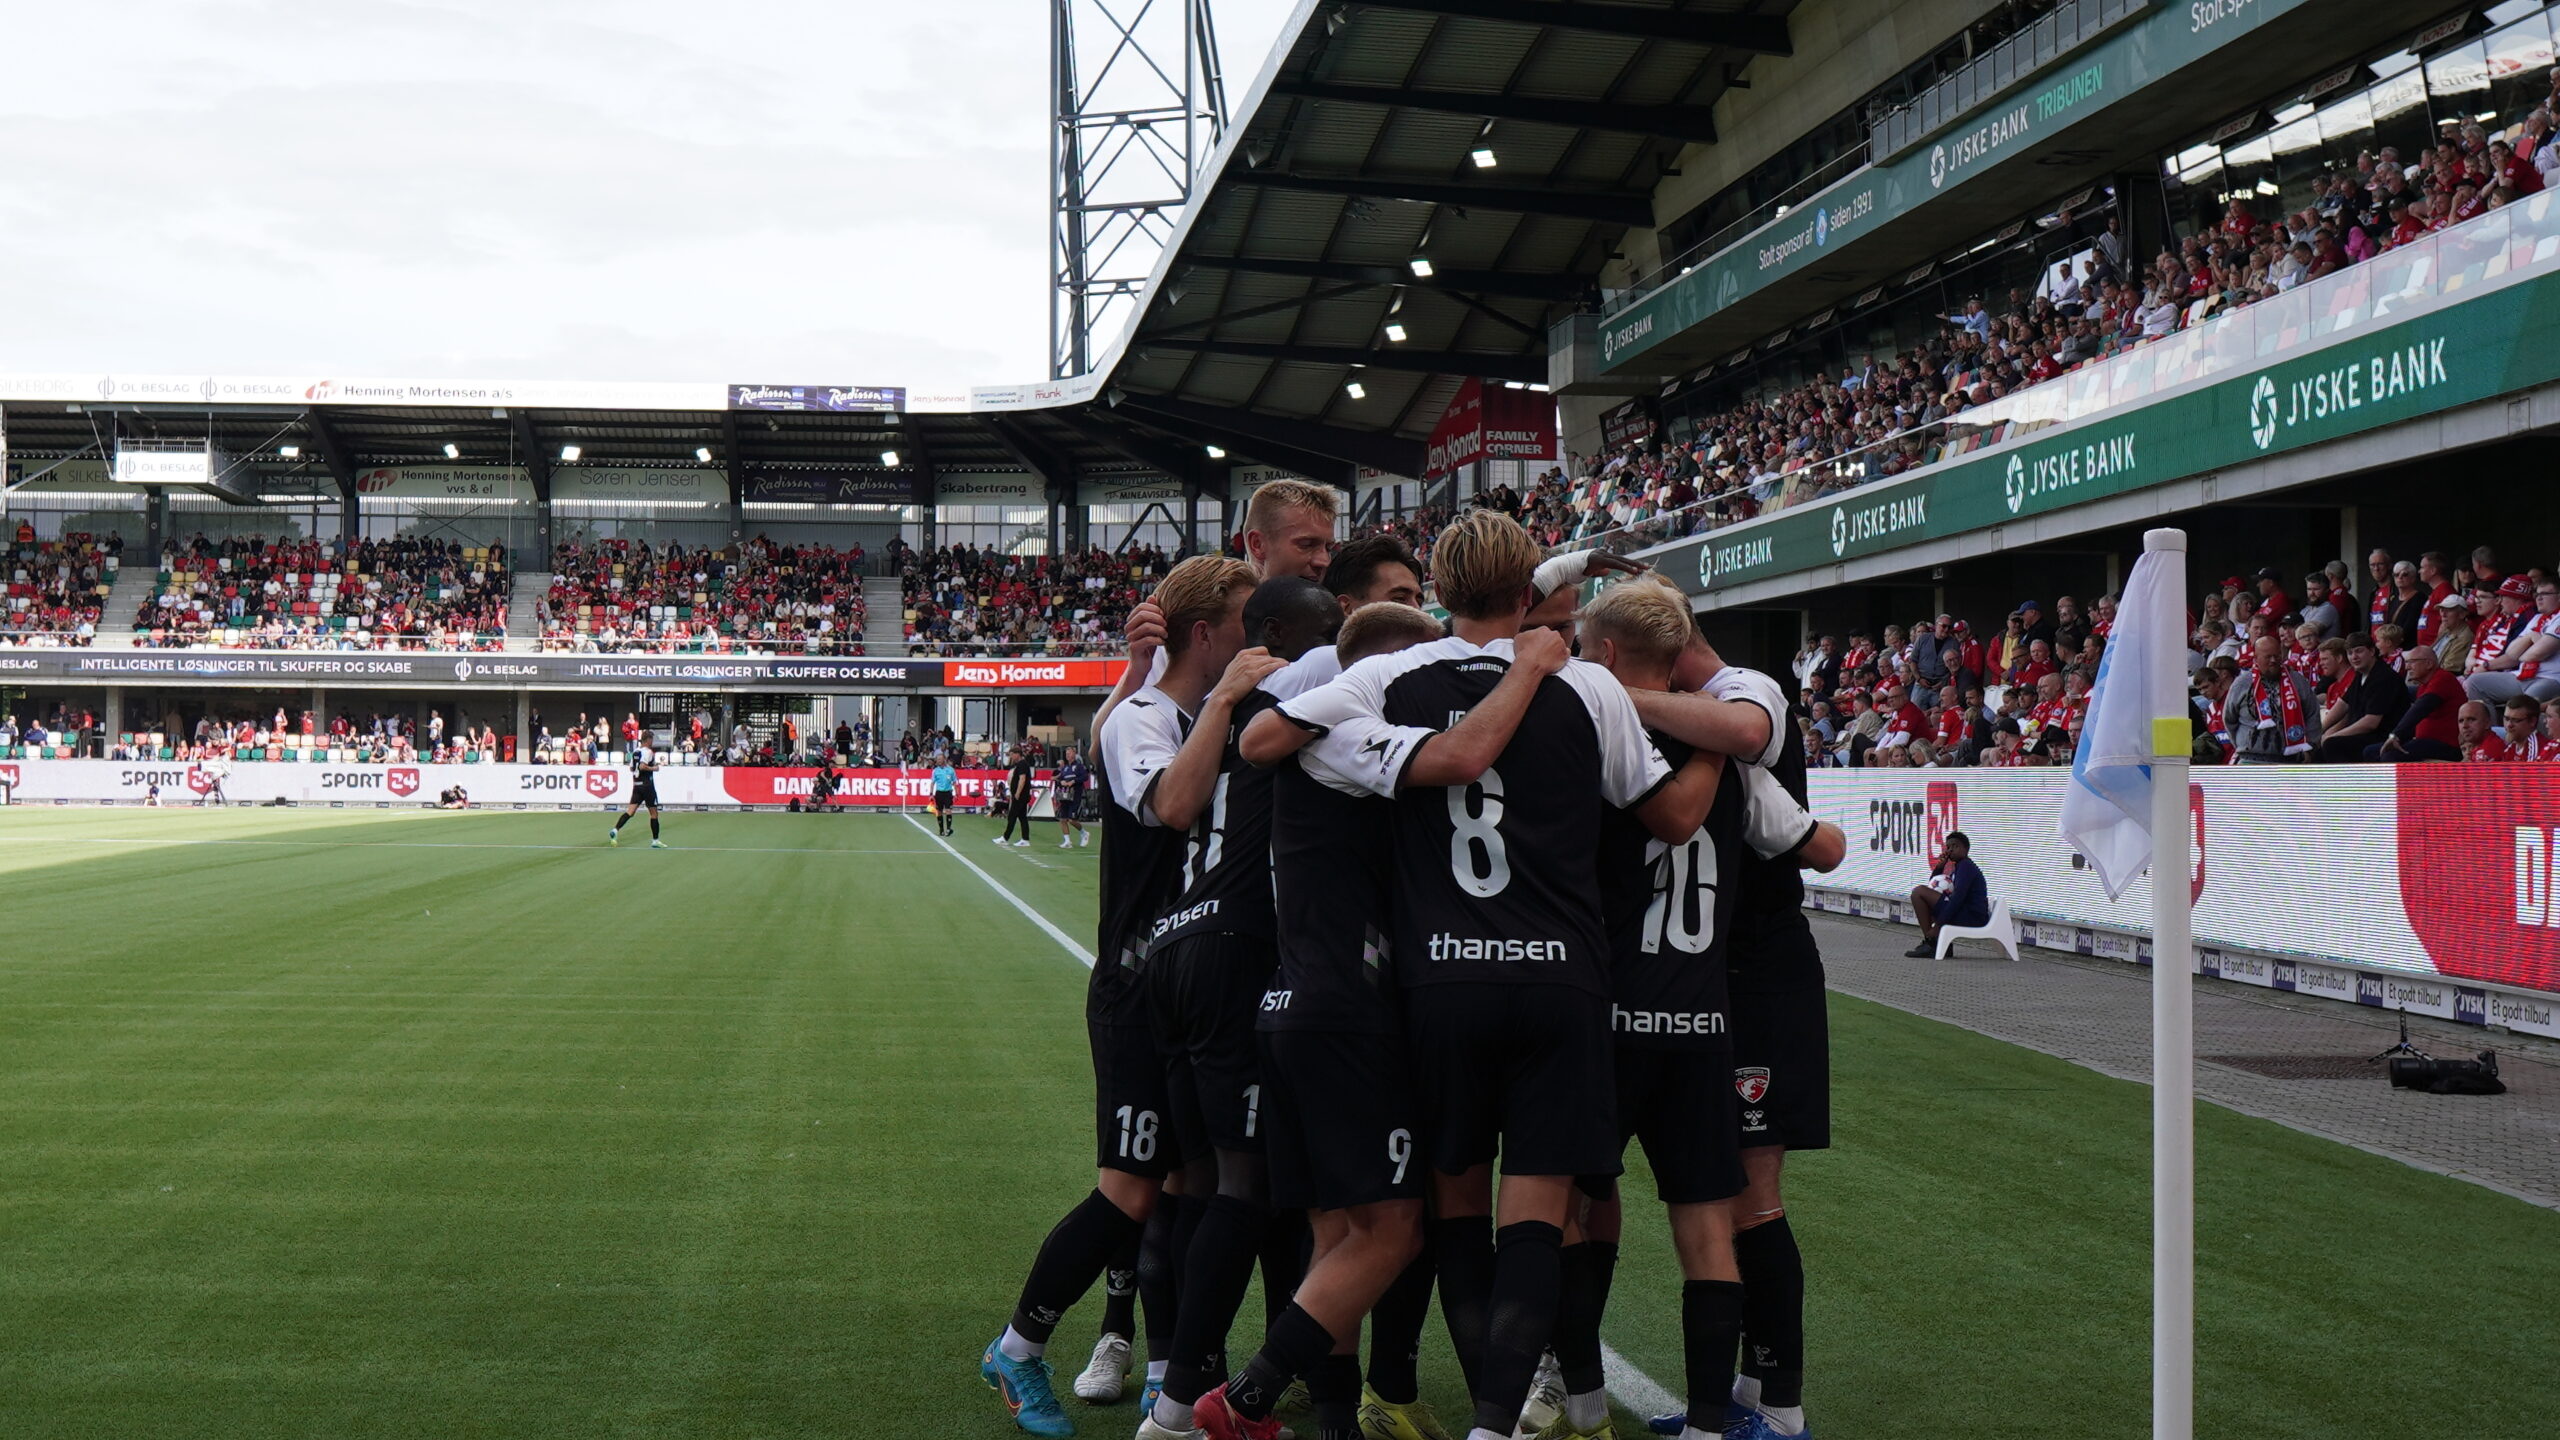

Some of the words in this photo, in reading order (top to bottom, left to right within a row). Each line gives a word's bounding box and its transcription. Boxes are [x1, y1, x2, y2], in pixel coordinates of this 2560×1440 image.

[2190, 0, 2225, 33] Stolt
[1949, 127, 1988, 172] JYSKE
[1991, 104, 2029, 148] BANK
[2036, 63, 2104, 122] TRIBUNEN
[1759, 244, 1776, 270] Stolt
[1776, 232, 1804, 265] sponsor
[1830, 205, 1852, 232] siden
[1852, 189, 1873, 220] 1991
[1613, 321, 1634, 351] JYSKE
[1634, 313, 1653, 340] BANK
[121, 383, 138, 393] OL
[141, 383, 190, 393] BESLAG
[223, 383, 240, 394] OL
[243, 384, 292, 394] BESLAG
[2286, 363, 2361, 426] JYSKE
[2371, 336, 2447, 402] BANK
[345, 385, 404, 400] Henning
[409, 386, 487, 398] Mortensen
[492, 386, 513, 399] a/s
[738, 386, 793, 406] Radisson
[828, 387, 882, 406] Radisson
[1447, 422, 1481, 467] Konrad
[1486, 430, 1539, 442] FAMILY
[1486, 443, 1543, 454] CORNER
[141, 463, 157, 472] OL
[160, 463, 205, 473] BESLAG
[2030, 449, 2080, 496] JYSKE
[2086, 432, 2135, 481] BANK
[401, 471, 449, 482] Henning
[453, 471, 515, 481] Mortensen
[579, 469, 631, 486] Søren
[638, 469, 701, 486] Jensen
[753, 475, 812, 495] Radisson
[446, 485, 466, 494] vvs
[470, 484, 479, 494] &
[482, 484, 493, 494] el
[839, 476, 898, 497] Radisson
[940, 482, 1026, 497] Skabertrang
[1849, 504, 1887, 543] JYSKE
[1890, 493, 1927, 531] BANK
[1713, 545, 1743, 576] JYSKE
[1744, 536, 1773, 567] BANK
[0, 659, 39, 669] ESLAG
[80, 658, 175, 671] INTELLIGENTE
[177, 659, 256, 671] LØSNINGER
[258, 660, 278, 672] TIL
[280, 660, 341, 673] SKUFFER
[343, 661, 365, 673] OG
[367, 661, 412, 674] SKABE
[475, 664, 492, 675] OL
[494, 664, 538, 676] BESLAG
[580, 664, 672, 677] INTELLIGENTE
[675, 664, 752, 678] LØSNINGER
[755, 666, 775, 678] TIL
[777, 666, 836, 678] SKUFFER
[839, 667, 860, 679] OG
[863, 668, 907, 679] SKABE
[954, 665, 998, 684] Jens
[1000, 664, 1066, 683] Konrad
[122, 771, 184, 786] SPORT
[321, 773, 384, 788] SPORT
[391, 772, 418, 789] 24
[521, 774, 583, 790] SPORT
[590, 774, 616, 791] 24
[774, 777, 890, 796] DANARKS
[1869, 799, 1924, 857] SPORT
[1930, 801, 1955, 858] 24
[1151, 899, 1220, 942] ansen
[1428, 932, 1567, 961] thansen
[2078, 932, 2093, 948] JYSK
[2204, 954, 2220, 970] JYSK
[2224, 956, 2231, 970] Et
[2231, 958, 2245, 975] godt
[2246, 959, 2264, 977] tilbud
[2276, 964, 2296, 982] JYSK
[2300, 969, 2308, 984] Et
[2309, 971, 2325, 989] godt
[2325, 972, 2346, 991] tilbud
[2361, 979, 2383, 998] JYSK
[2388, 983, 2397, 1000] Et
[2398, 985, 2416, 1005] godt
[2417, 987, 2442, 1007] tilbud
[2459, 993, 2484, 1015] JYSK
[2492, 999, 2501, 1017] Et
[2502, 1002, 2523, 1023] godt
[2524, 1004, 2551, 1026] tilbud
[1611, 1002, 1725, 1034] hansen
[1116, 1104, 1159, 1162] 18
[1742, 1123, 1767, 1132] hummel
[1388, 1128, 1411, 1184] 9
